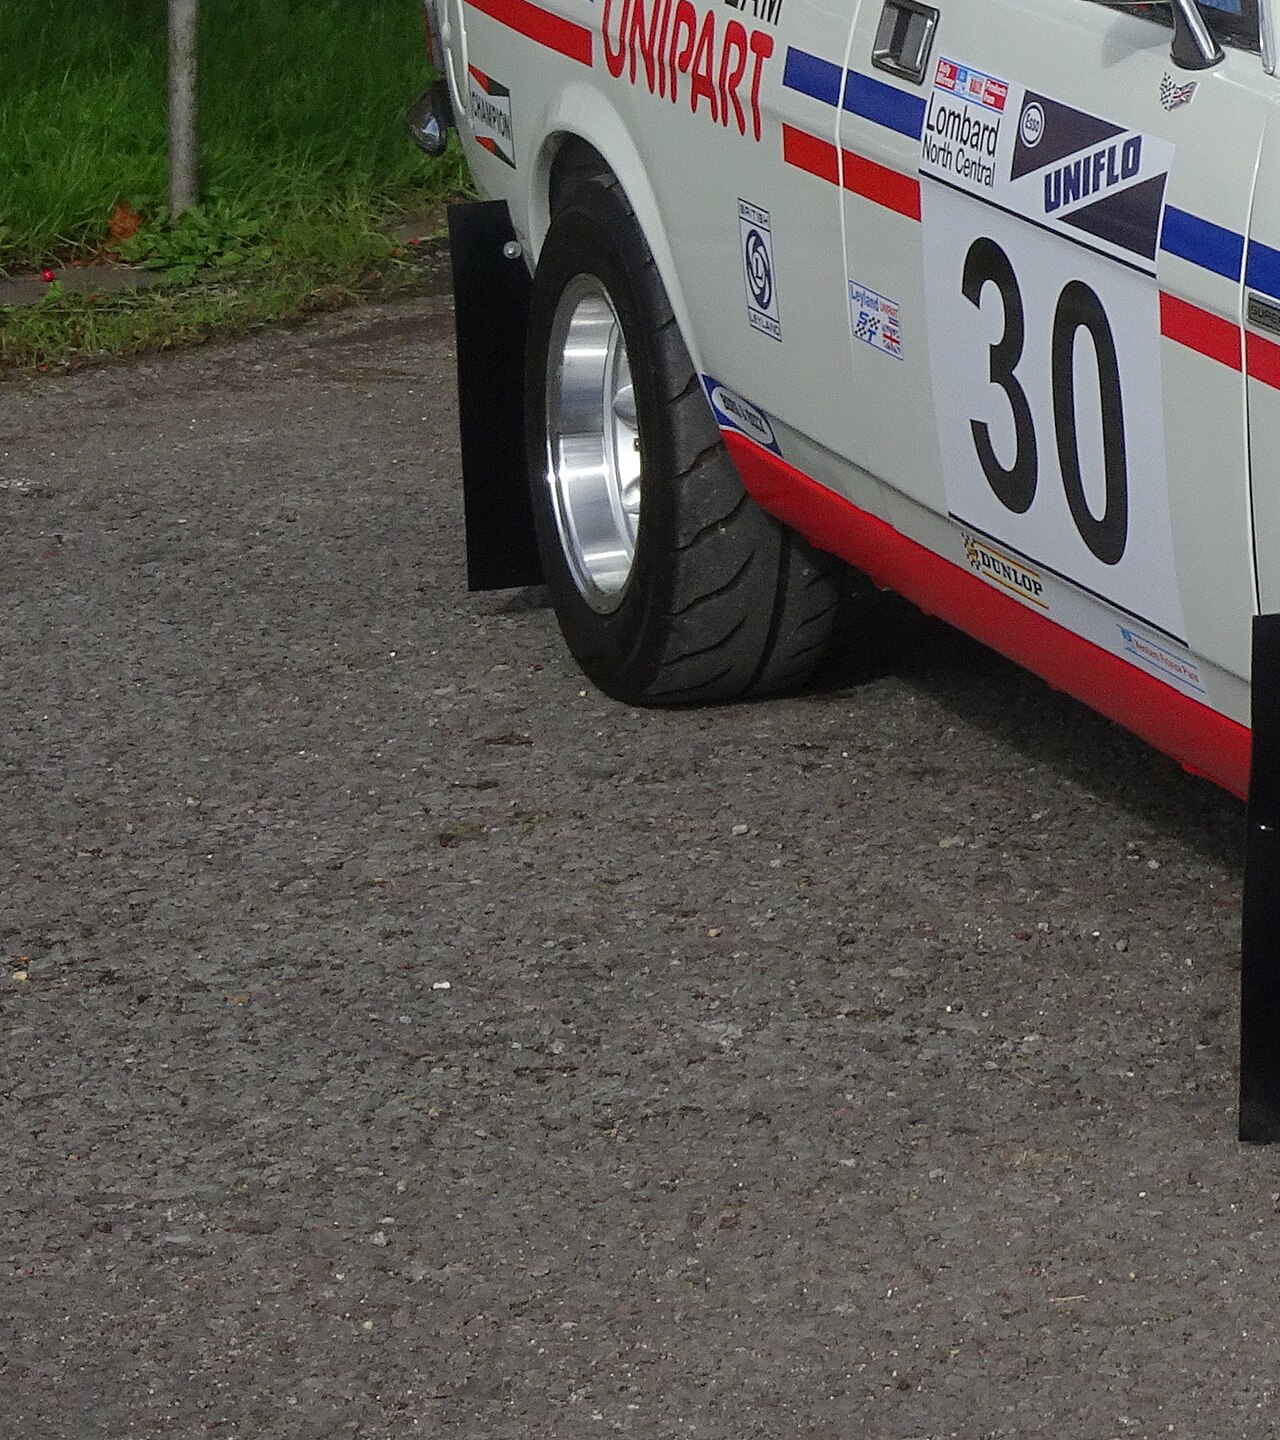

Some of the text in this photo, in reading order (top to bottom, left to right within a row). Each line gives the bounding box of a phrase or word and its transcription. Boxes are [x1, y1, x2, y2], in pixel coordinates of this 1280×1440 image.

[926, 91, 1001, 158] Lombard
[1024, 116, 1041, 134] Esso
[922, 134, 996, 189] North Central
[1043, 134, 1142, 214] UNIFLO
[739, 203, 768, 225] BRITISH
[850, 284, 879, 312] Leyland
[750, 313, 781, 336] LEYLAND
[962, 236, 1128, 565] 30
[980, 547, 1044, 596] DUNLOP
